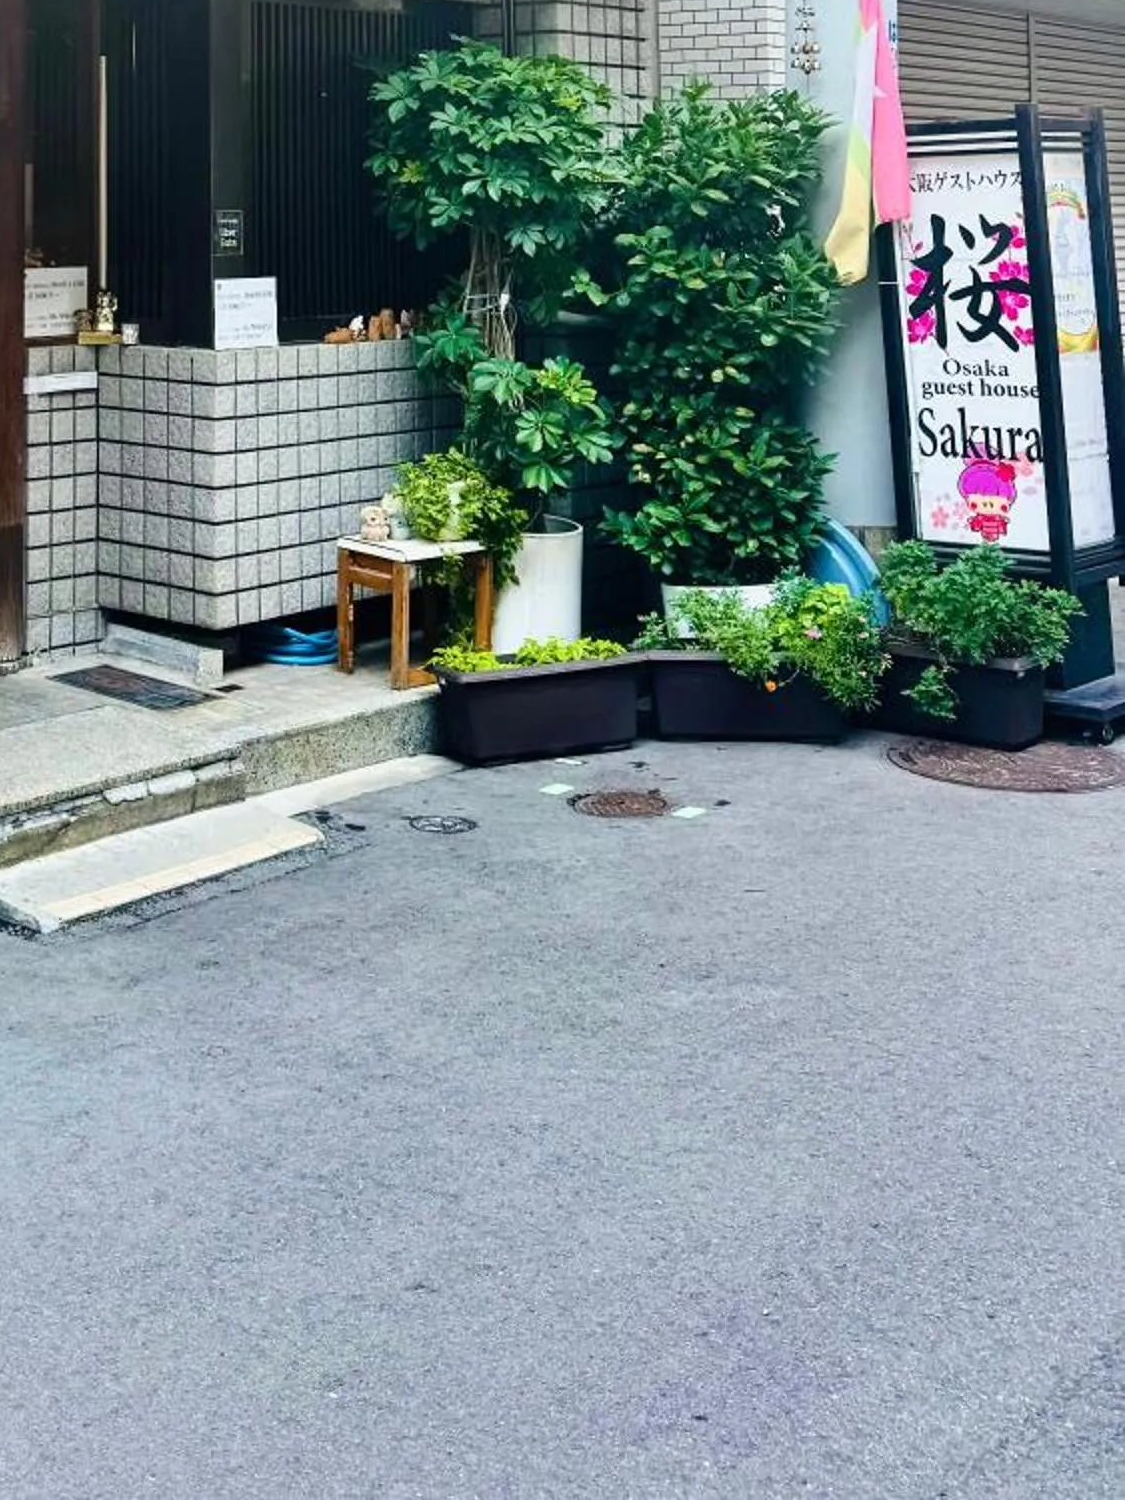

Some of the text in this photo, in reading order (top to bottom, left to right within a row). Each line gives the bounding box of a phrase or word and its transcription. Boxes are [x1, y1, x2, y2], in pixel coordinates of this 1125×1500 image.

[909, 213, 1032, 352] 桜
[942, 357, 1009, 378] Osaka
[922, 378, 1040, 400] guest house
[918, 407, 1044, 464] Sakura
